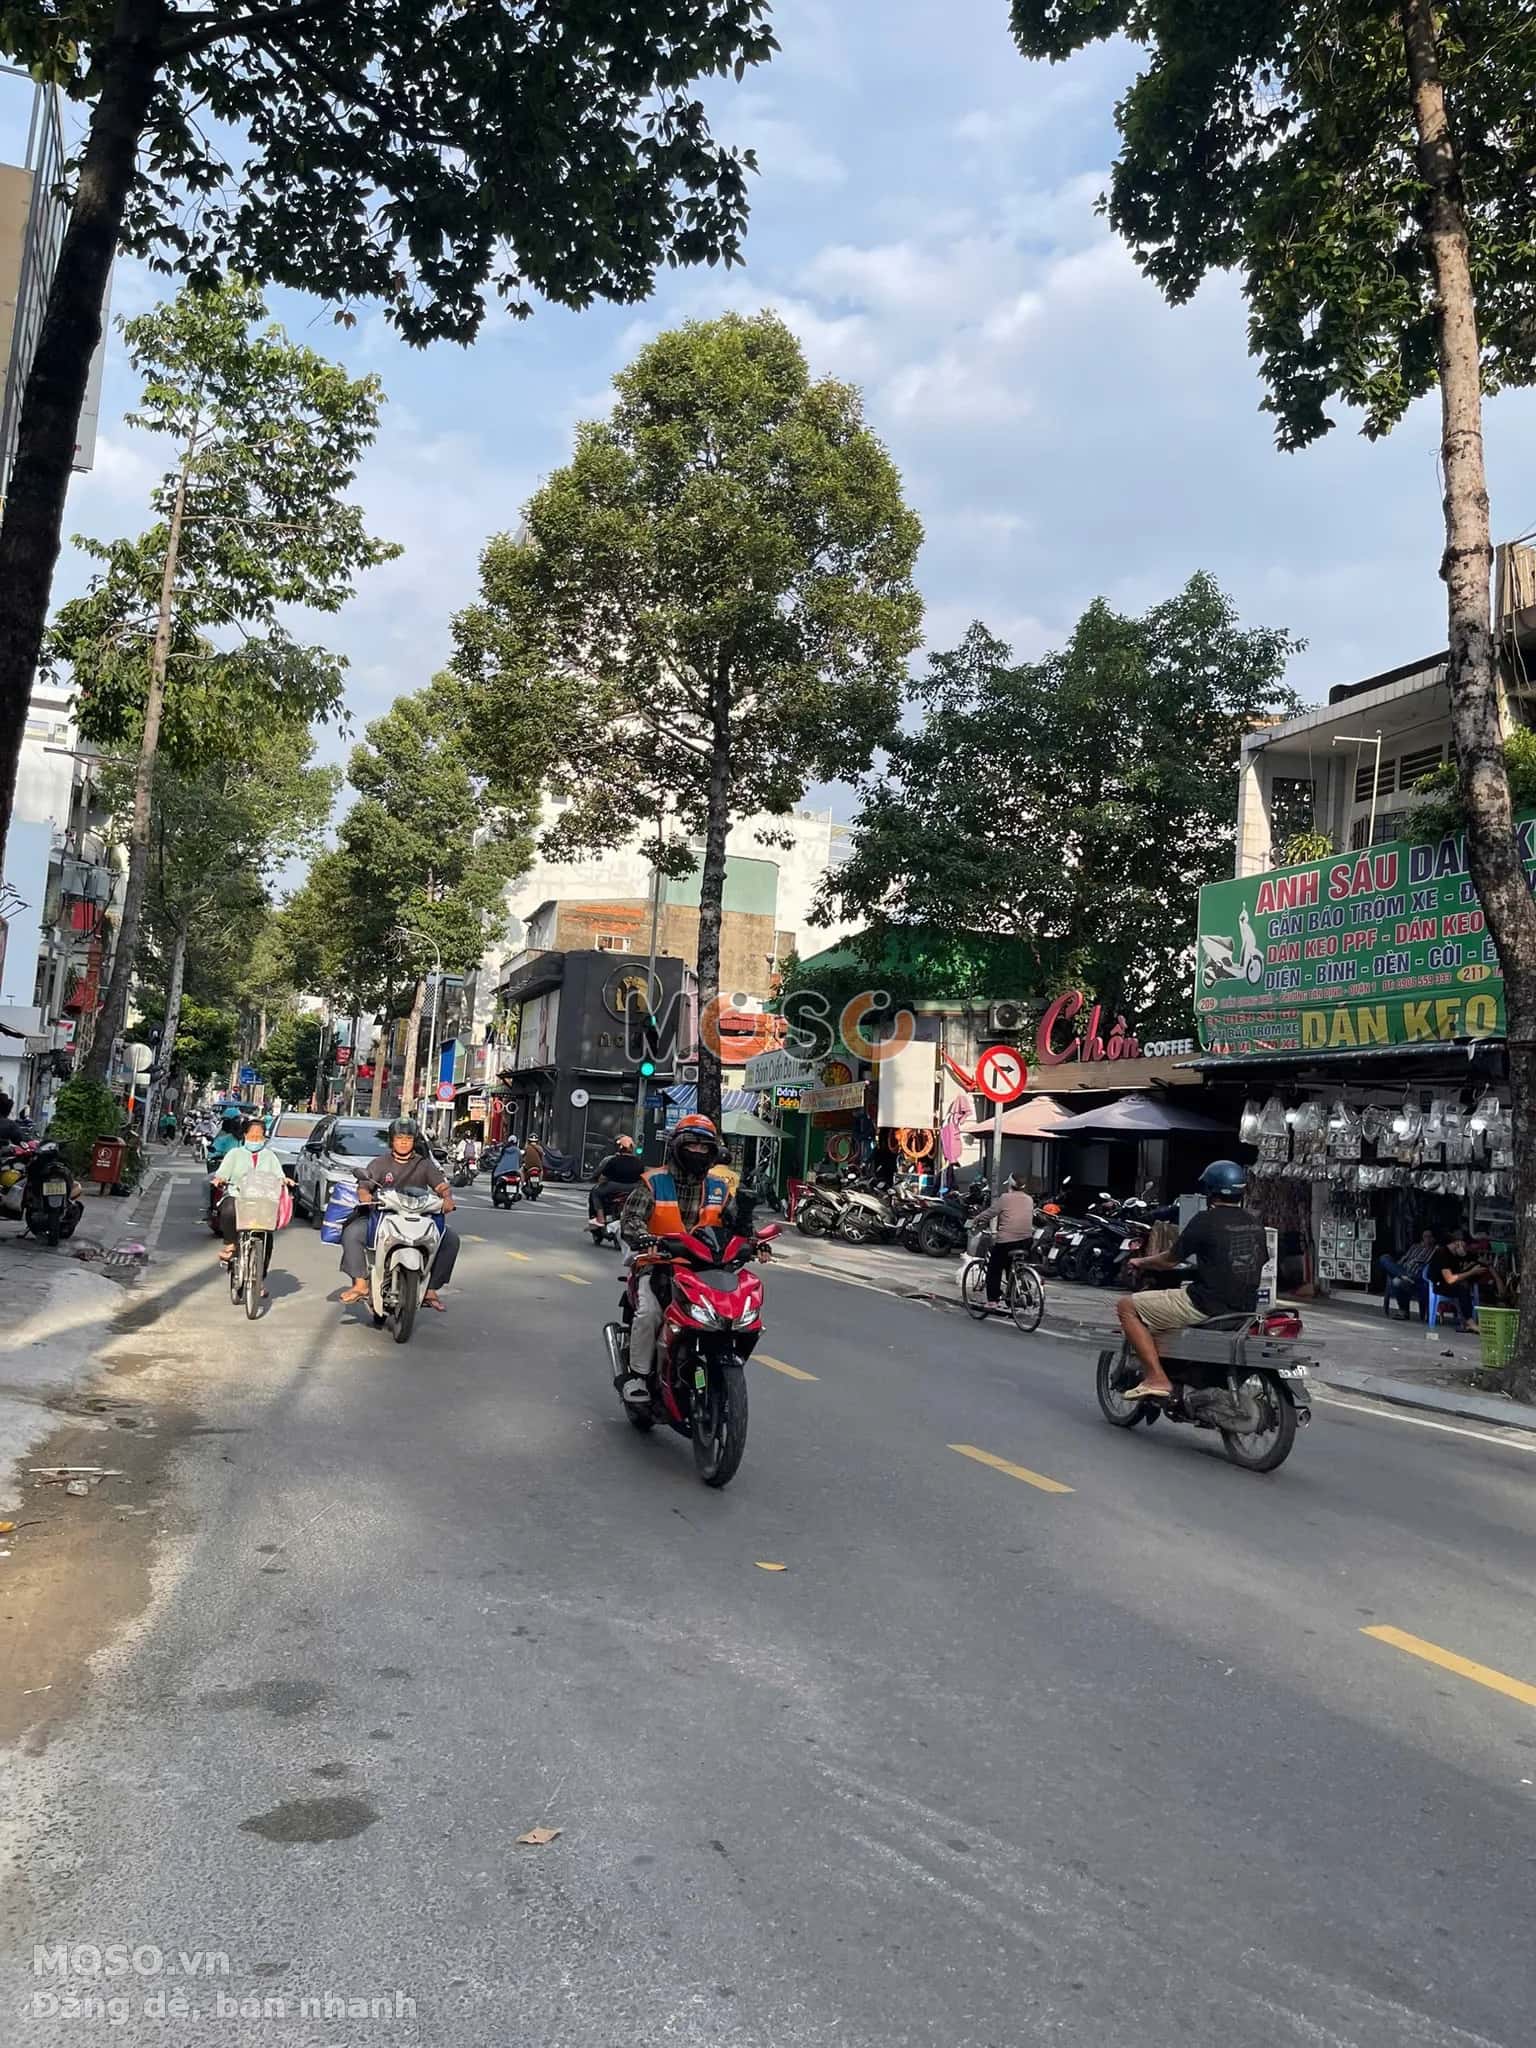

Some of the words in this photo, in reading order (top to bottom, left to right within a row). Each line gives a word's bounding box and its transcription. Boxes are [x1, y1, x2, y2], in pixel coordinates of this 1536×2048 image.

[1255, 870, 1320, 916] ANH
[1328, 850, 1398, 901] SÁU
[1408, 830, 1471, 885] DÁ
[1268, 910, 1303, 940] GẮN
[1307, 905, 1344, 932] BÁO
[1350, 895, 1405, 925] TRỘM
[1410, 887, 1439, 914] XE
[1266, 940, 1301, 965] DÁN
[1304, 935, 1338, 959] KEO
[1343, 928, 1377, 954] PPF
[1395, 916, 1437, 945] DÁN
[1442, 910, 1484, 937] KEO
[1316, 959, 1356, 985] BÌNH
[1373, 950, 1411, 977] ĐÈN
[1428, 940, 1462, 969] CÒI
[1463, 966, 1484, 981] 211
[1404, 995, 1497, 1041] KEO
[1144, 1038, 1194, 1057] COFFEE
